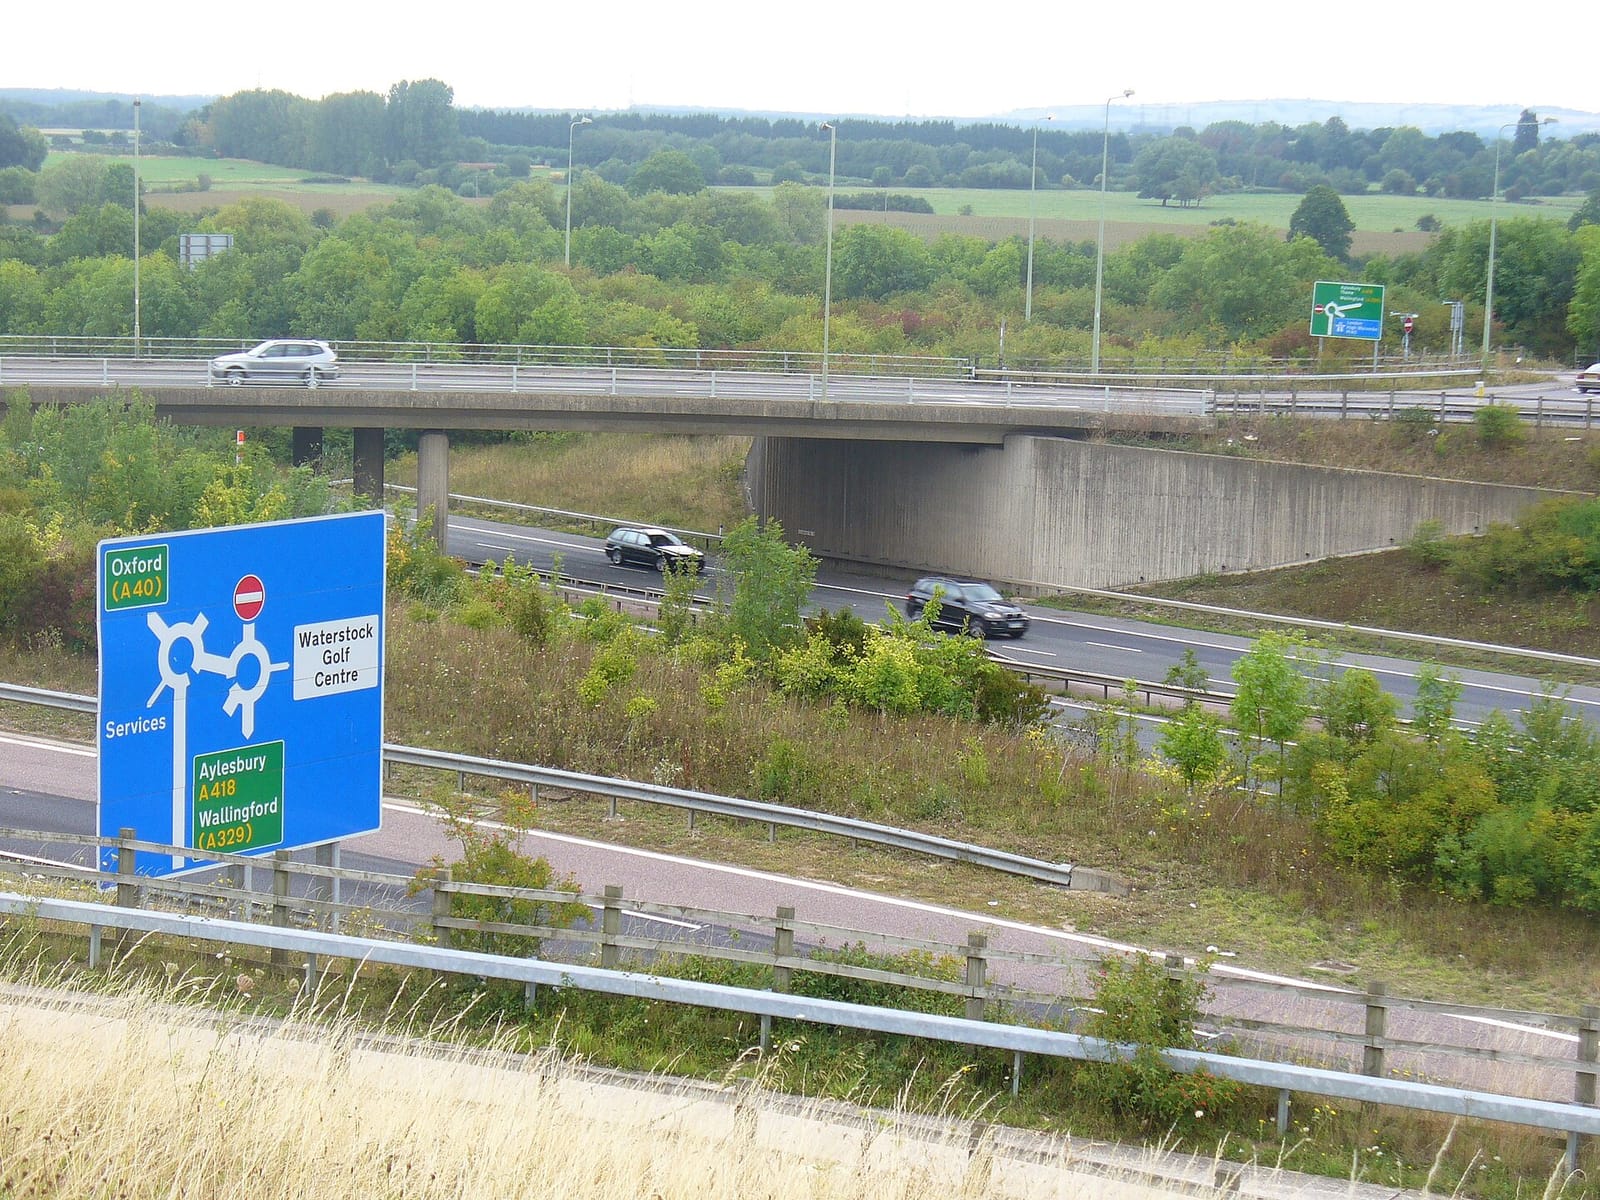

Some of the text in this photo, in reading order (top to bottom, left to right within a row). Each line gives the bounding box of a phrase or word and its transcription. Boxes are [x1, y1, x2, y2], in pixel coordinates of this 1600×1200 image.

[111, 553, 162, 577] Oxford
[112, 575, 162, 603] (A40)
[298, 623, 373, 648] Waterstock
[322, 646, 350, 665] Golf
[314, 668, 358, 687] Centre
[105, 716, 166, 739] Services
[199, 755, 266, 781] Aylesbury
[199, 779, 236, 802] A418
[199, 796, 278, 828] Wallingford
[198, 822, 253, 850] (A329)
